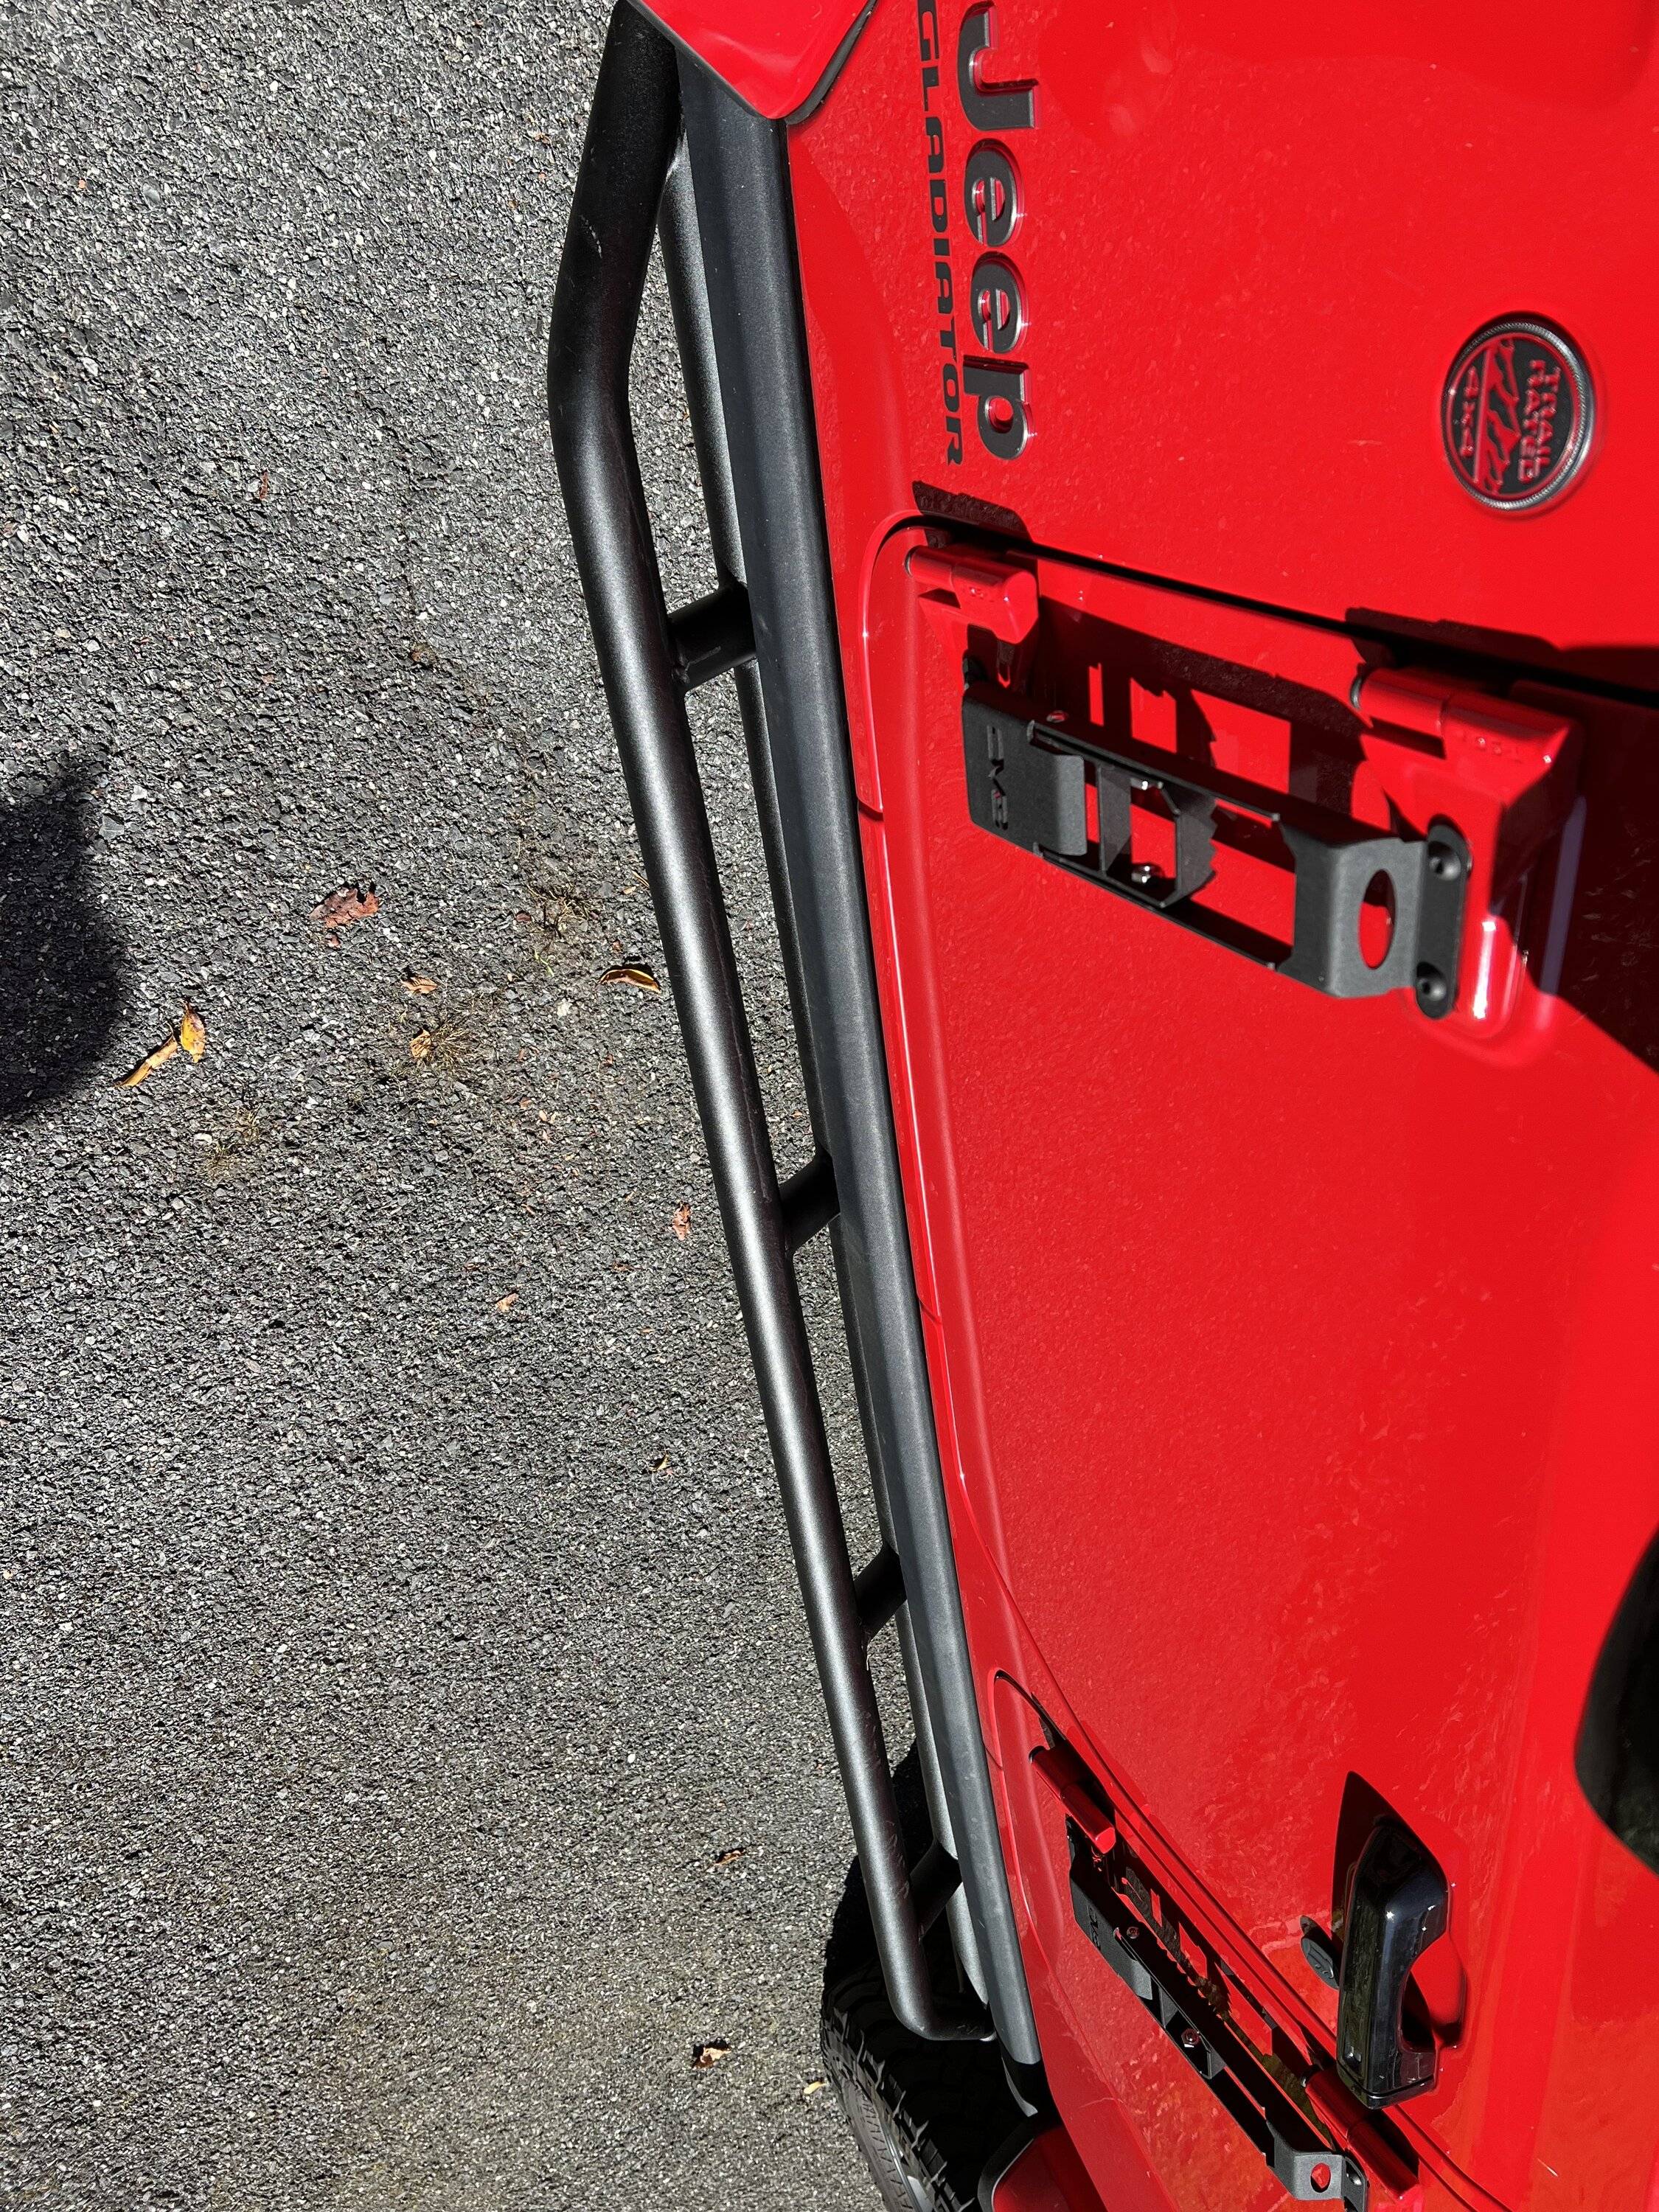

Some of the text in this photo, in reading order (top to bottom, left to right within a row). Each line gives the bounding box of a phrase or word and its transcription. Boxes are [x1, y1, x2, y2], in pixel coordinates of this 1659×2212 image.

[917, 0, 963, 465] GLADIATOR
[957, 1, 1040, 460] Jeep
[1517, 360, 1548, 484] RATED
[1534, 366, 1561, 478] TRAIL
